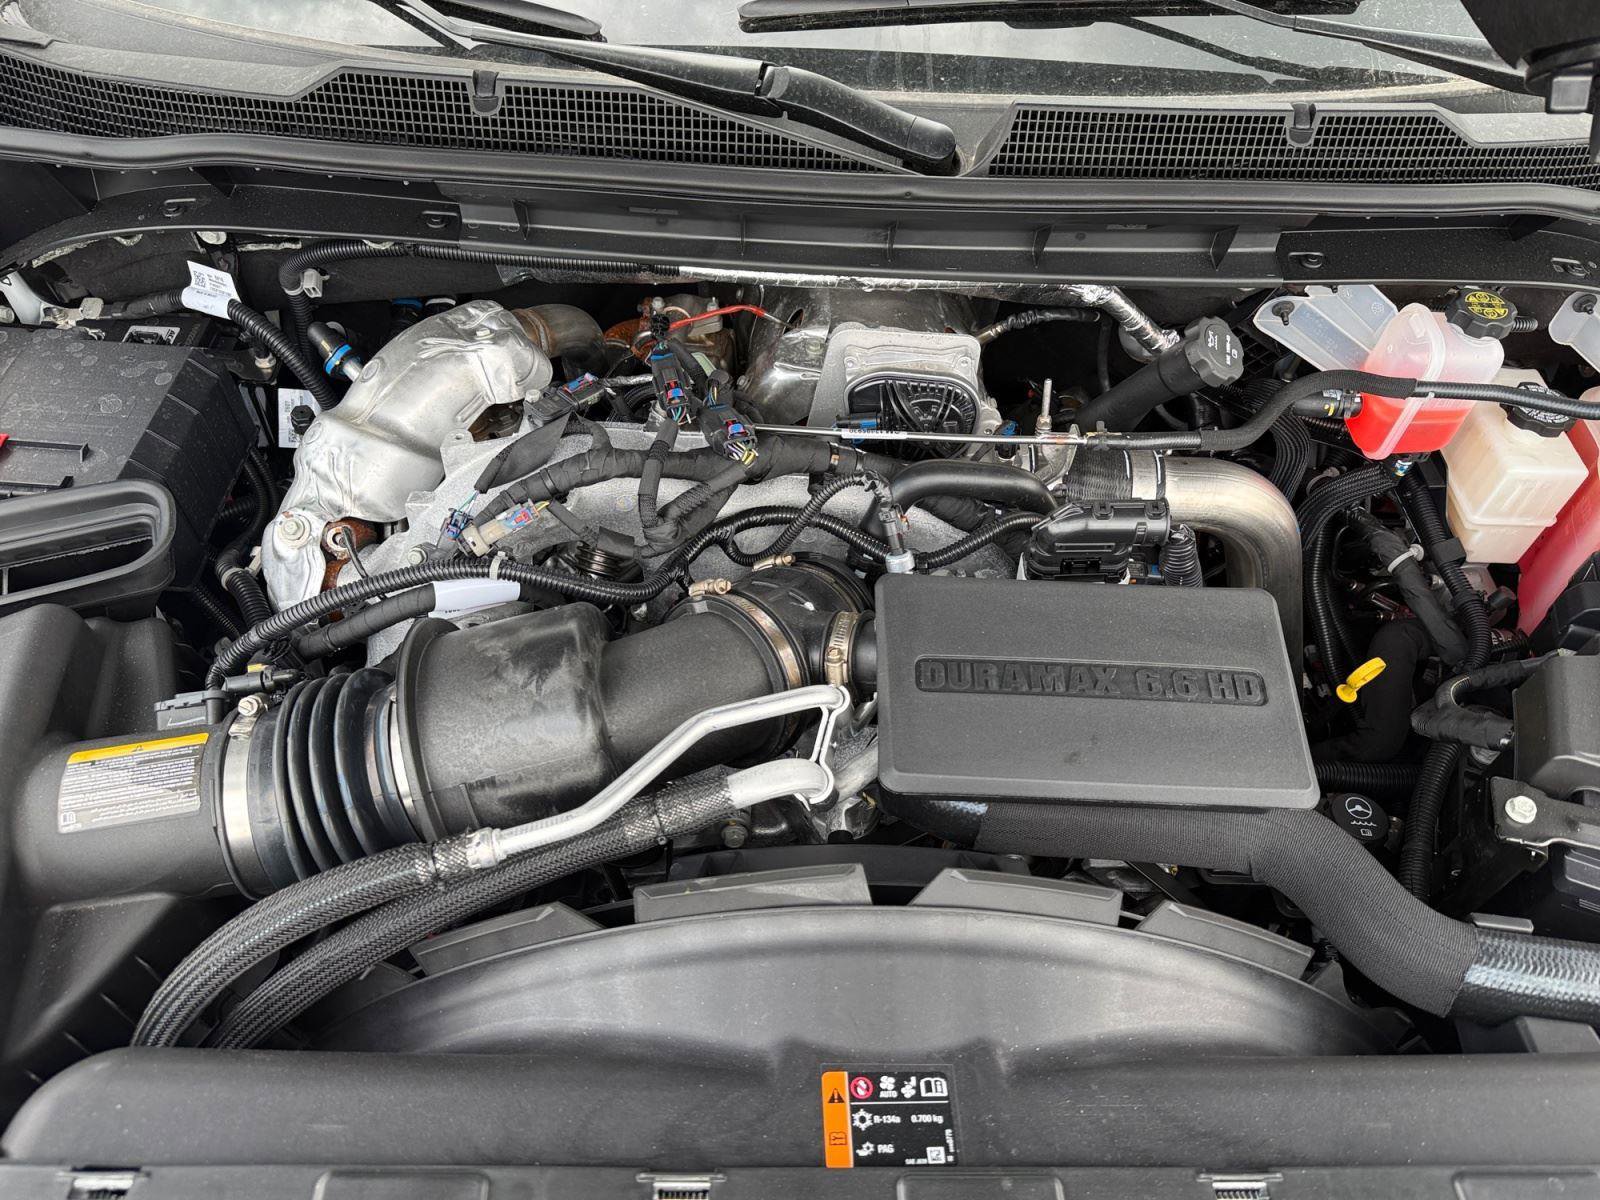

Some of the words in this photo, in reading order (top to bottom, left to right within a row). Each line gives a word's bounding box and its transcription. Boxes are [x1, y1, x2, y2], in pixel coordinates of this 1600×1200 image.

[920, 661, 1121, 695] DURAMAX
[1136, 668, 1199, 700] 6.6
[1207, 671, 1263, 701] HD
[879, 1090, 898, 1098] AUTO
[873, 1114, 901, 1123] R-134a
[910, 1114, 932, 1123] 0.700
[932, 1114, 944, 1124] kg
[877, 1144, 895, 1154] PAG
